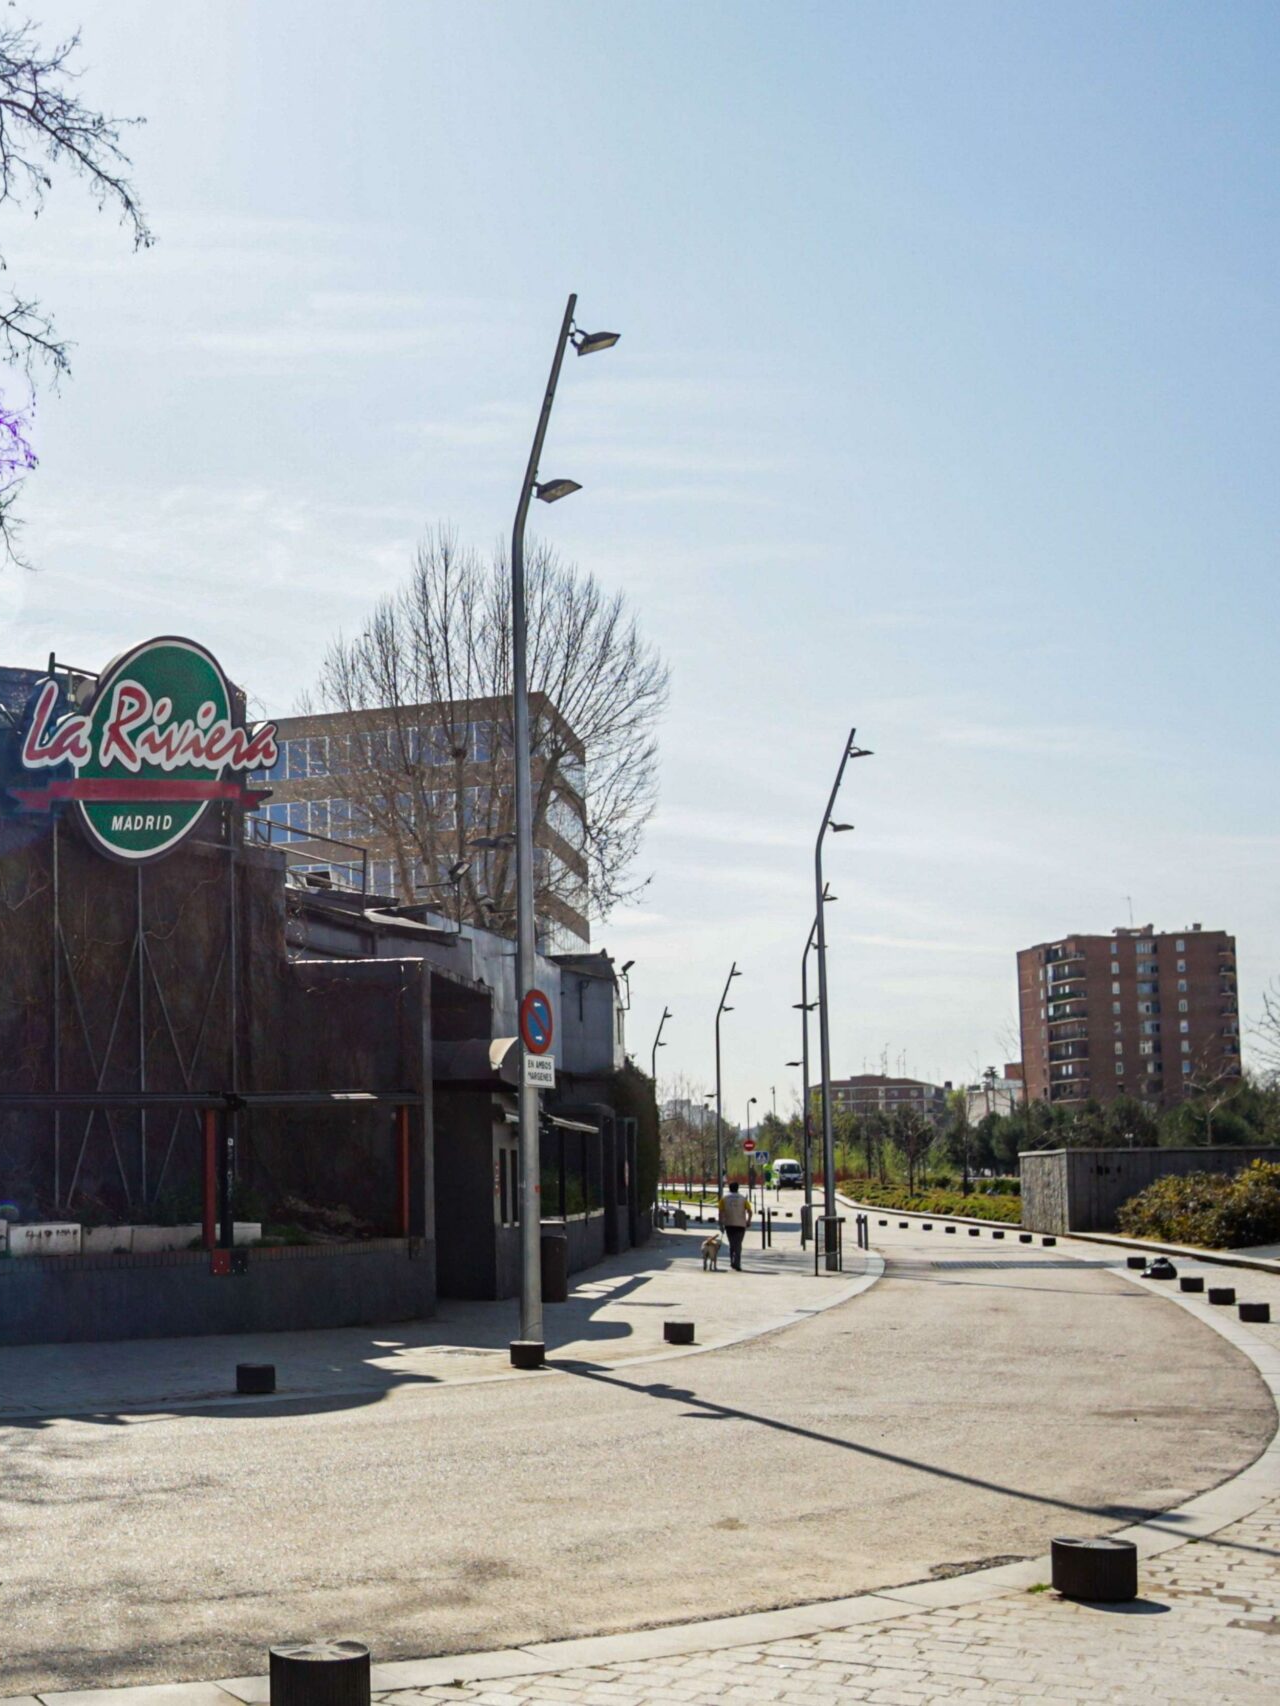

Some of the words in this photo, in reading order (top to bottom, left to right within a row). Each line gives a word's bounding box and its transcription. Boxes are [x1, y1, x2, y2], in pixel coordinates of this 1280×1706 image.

[23, 681, 91, 767] La
[100, 680, 278, 771] Riviera
[111, 815, 172, 831] MADRID
[528, 1060, 535, 1068] EN
[536, 1061, 552, 1070] AMBOS
